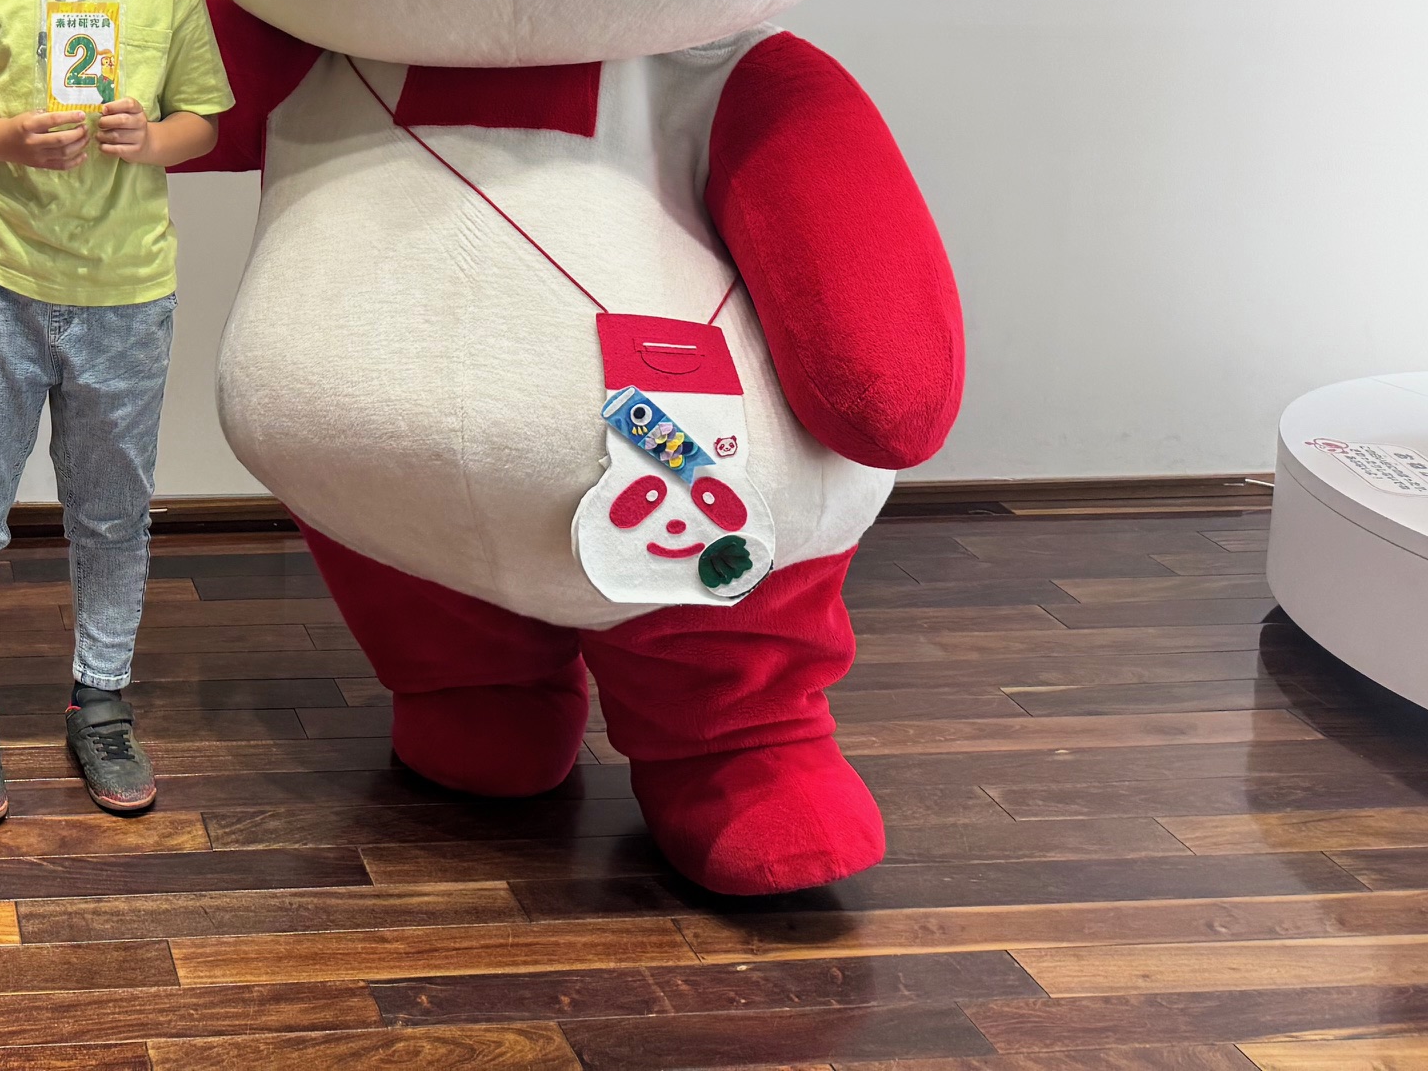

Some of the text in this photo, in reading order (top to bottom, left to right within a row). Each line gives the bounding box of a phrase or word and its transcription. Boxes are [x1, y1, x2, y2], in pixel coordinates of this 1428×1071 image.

[56, 17, 111, 29] 素材研究員
[64, 33, 99, 88] 2
